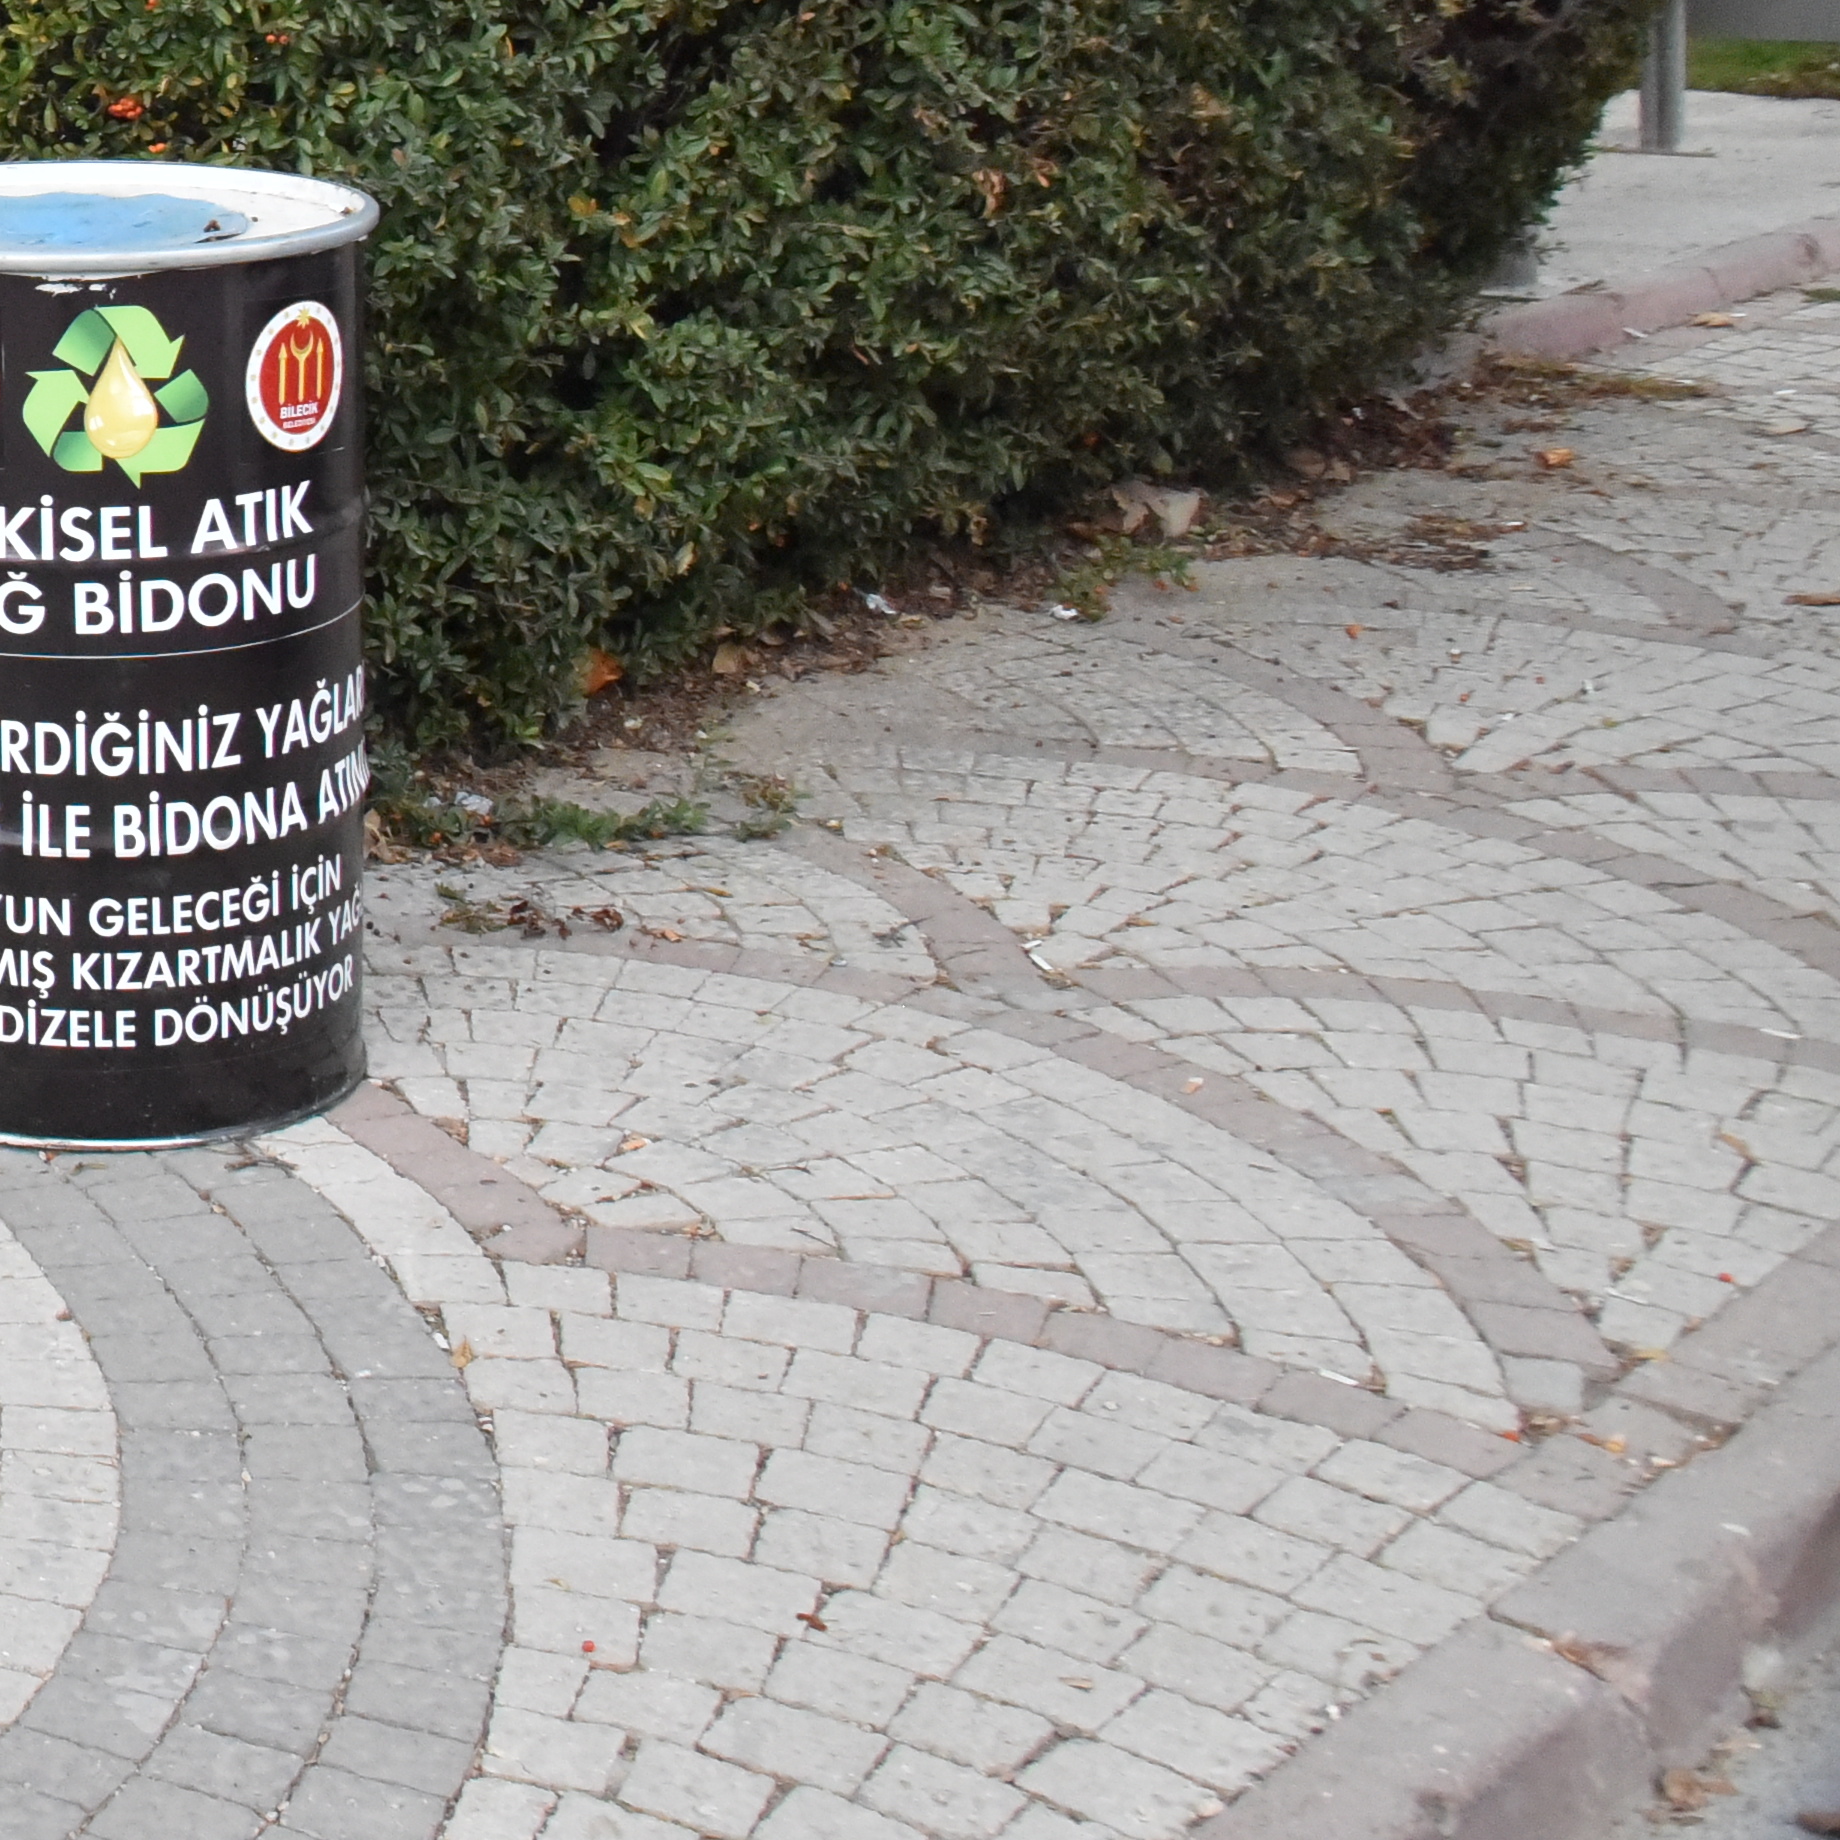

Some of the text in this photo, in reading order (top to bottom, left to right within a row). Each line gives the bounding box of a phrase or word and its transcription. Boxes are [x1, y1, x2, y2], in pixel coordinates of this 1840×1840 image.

[280, 400, 319, 420] BİLECİK
[190, 479, 314, 554] ATIK
[73, 554, 317, 636] BİDONU
[255, 660, 366, 759] YAĞLAR
[22, 790, 91, 859] İLE
[113, 790, 309, 859] BİDONA
[88, 869, 280, 937] GELECEĞİ
[292, 853, 342, 915] İÇİN
[72, 917, 322, 990] KIZARTMALIK
[153, 953, 354, 1047] DÖNÜŞÜYOR
